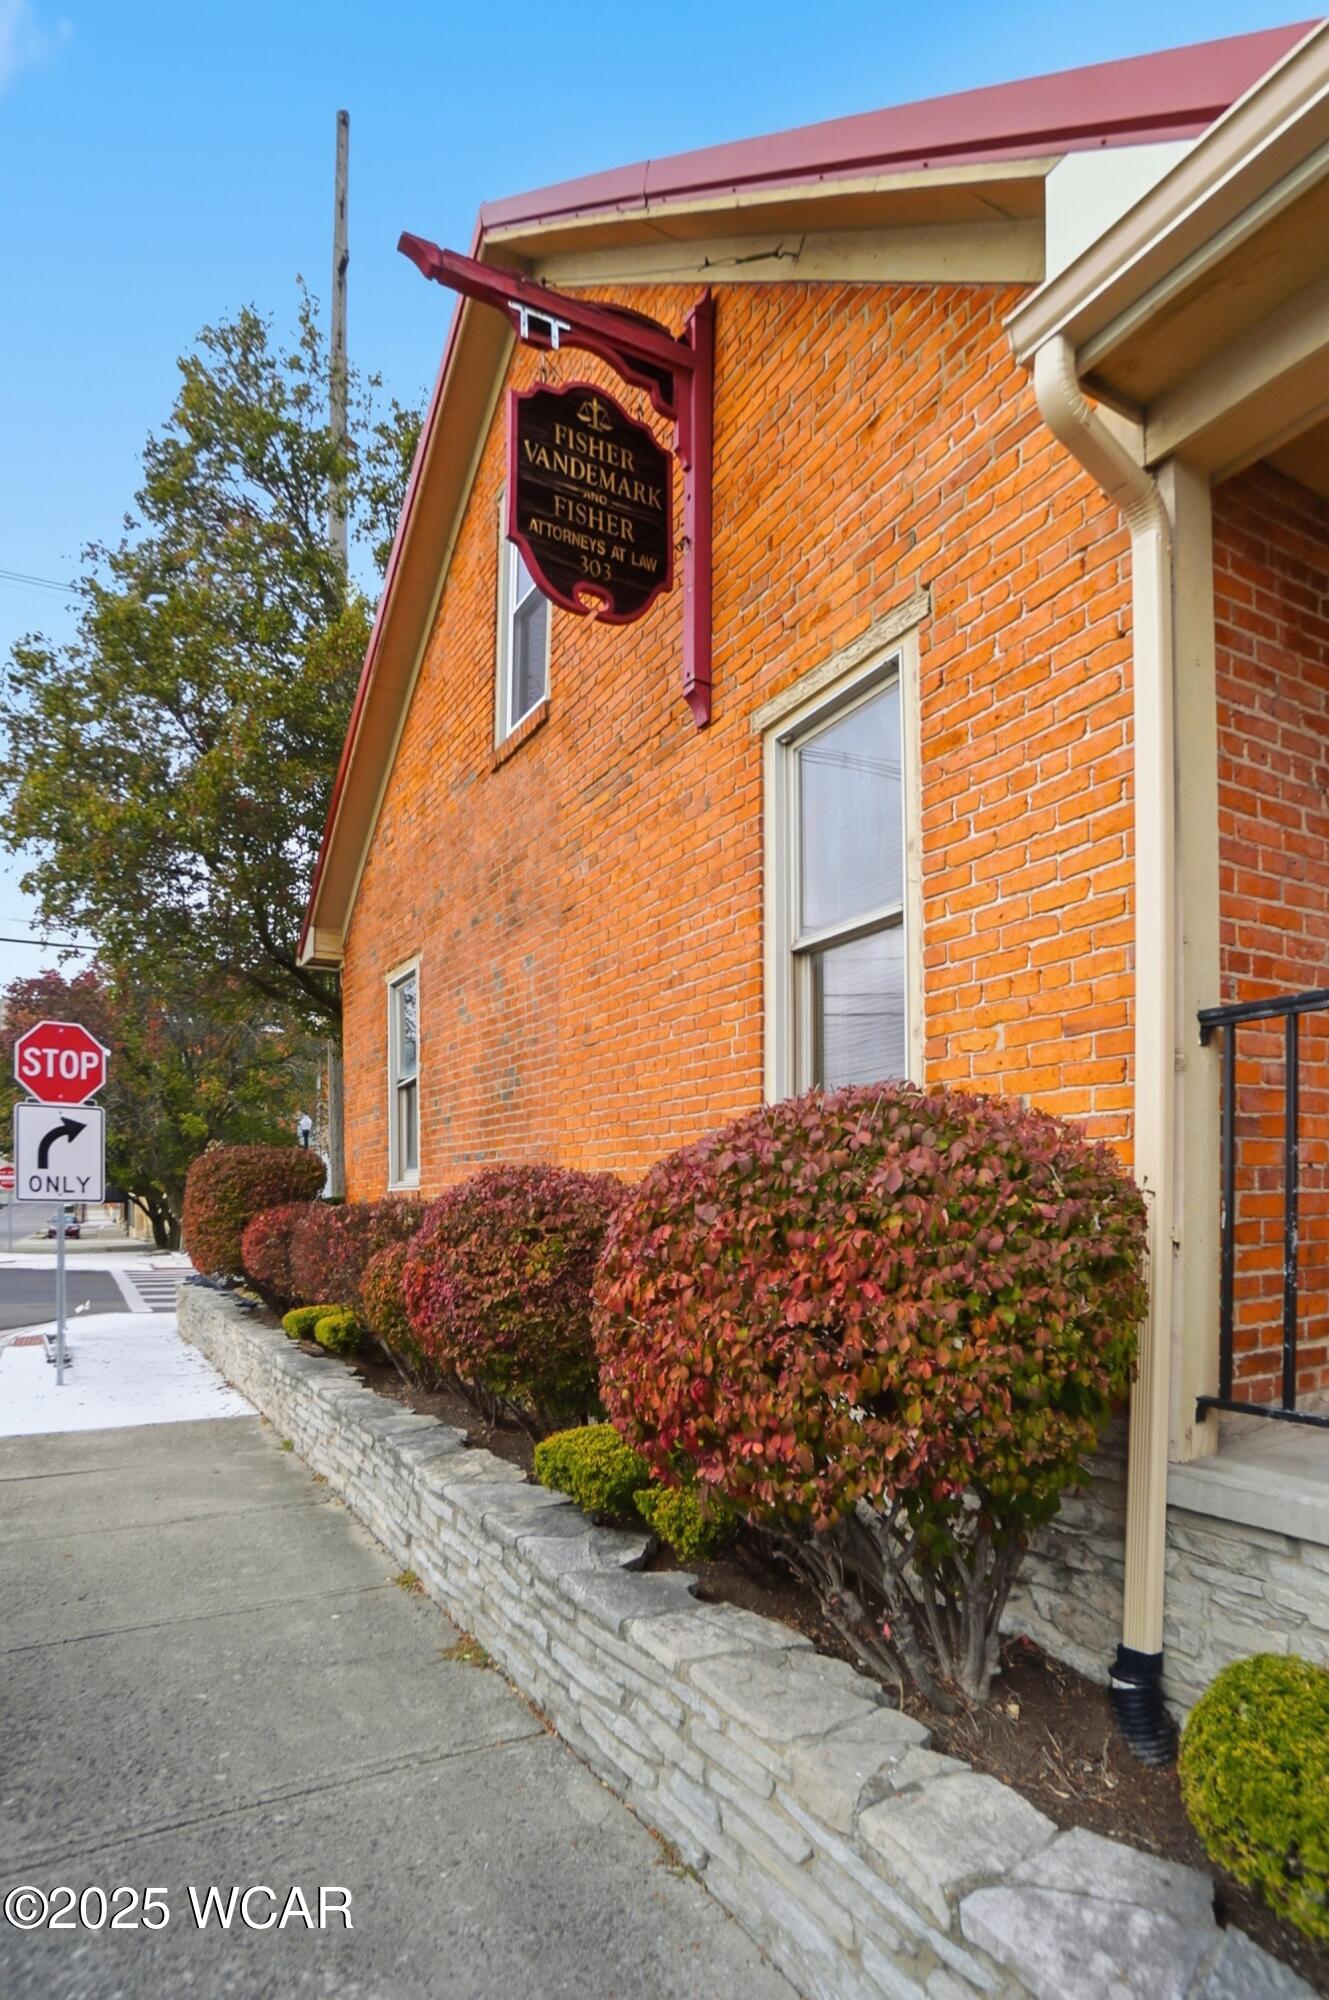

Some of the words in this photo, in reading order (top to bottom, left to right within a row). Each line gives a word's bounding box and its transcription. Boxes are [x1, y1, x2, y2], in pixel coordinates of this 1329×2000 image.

[555, 424, 633, 470] FISHER
[524, 440, 662, 510] VANDEMARK
[553, 496, 635, 542] FISHER
[529, 518, 606, 555] ATTORNEYS
[611, 546, 626, 563] AT
[632, 553, 658, 573] LAW
[580, 556, 612, 581] 303
[22, 1048, 99, 1080] STOP
[29, 1175, 91, 1193] ONLY
